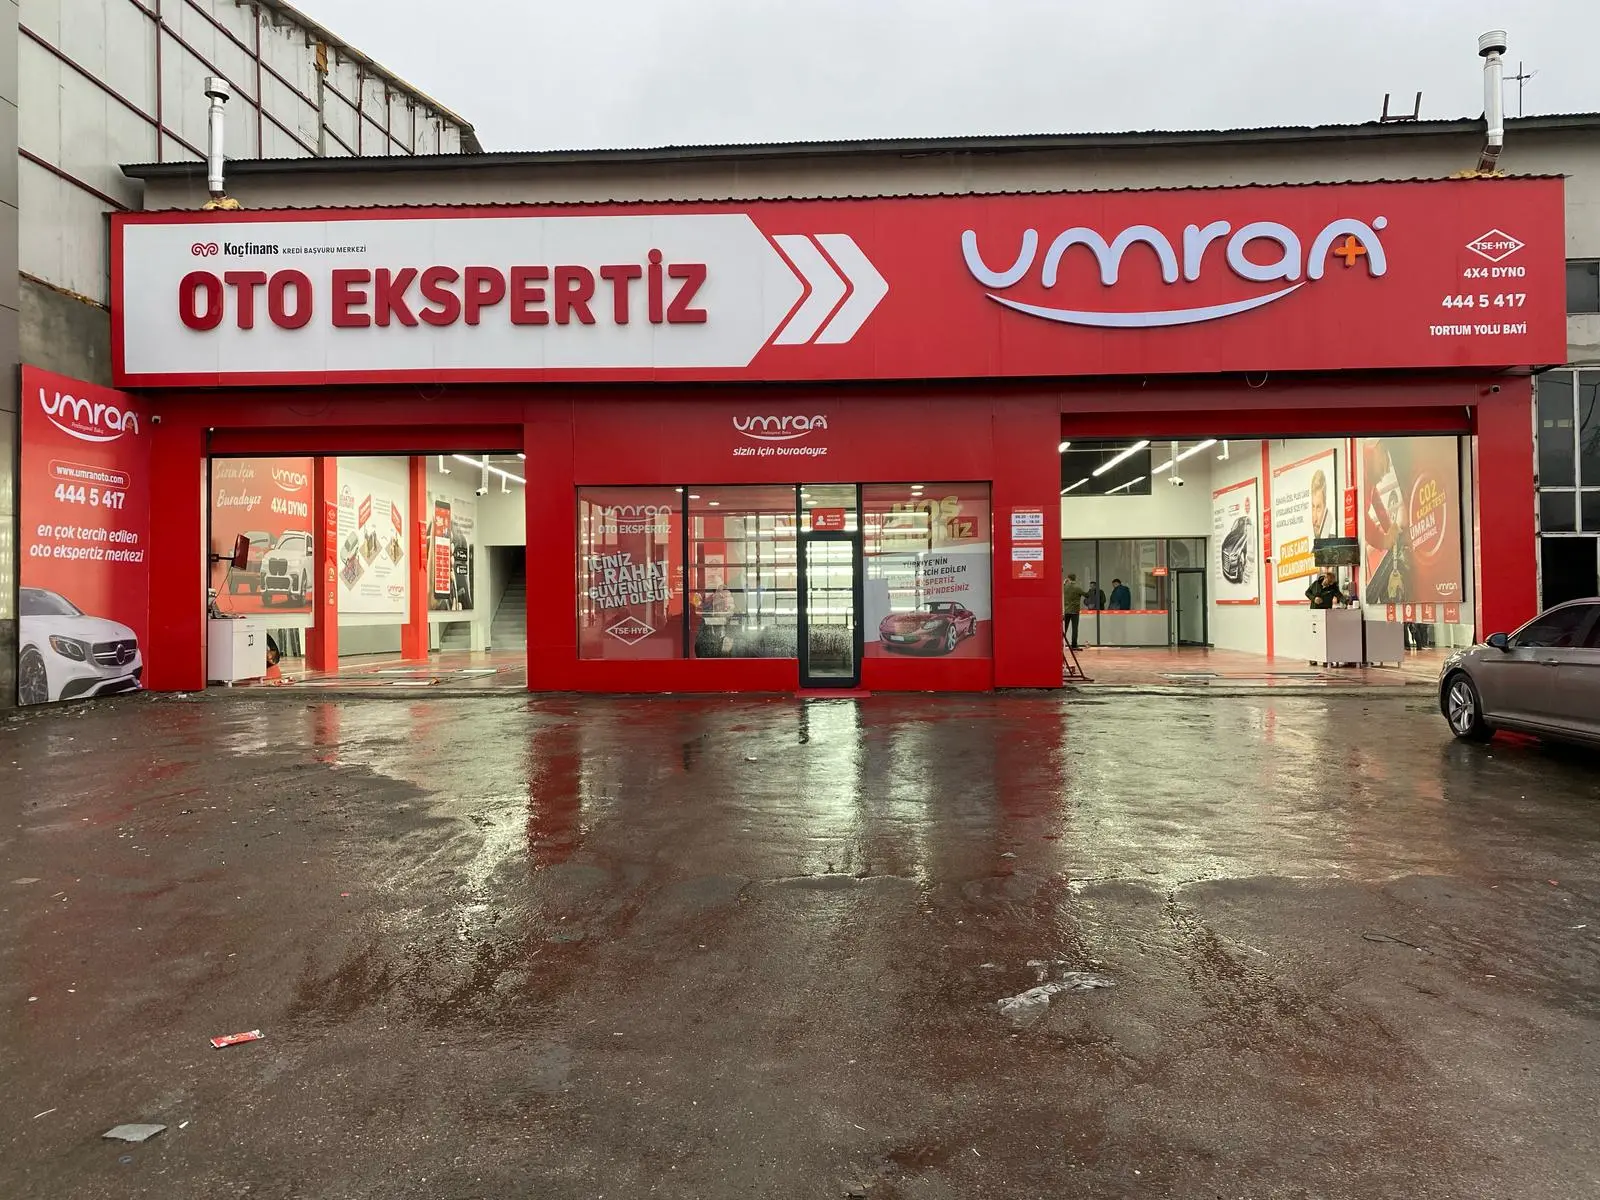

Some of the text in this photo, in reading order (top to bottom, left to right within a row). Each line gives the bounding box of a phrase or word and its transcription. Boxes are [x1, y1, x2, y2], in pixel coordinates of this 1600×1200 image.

[223, 242, 367, 257] Koçfinans KREDİ BAŞVURU MERKEZİ
[1474, 241, 1516, 250] TSE-HYB
[1463, 266, 1526, 278] 4X4 DYNO
[178, 248, 708, 331] OTO EKSPERTİZ
[1442, 293, 1527, 308] 444 5 417
[1429, 320, 1527, 336] TORTUM YOLU BAYİ
[40, 387, 139, 435] umran
[732, 414, 828, 431] umran
[732, 445, 828, 457] sizin için buradayız
[56, 466, 124, 484] www.umranoto.com
[271, 467, 308, 487] umran
[54, 483, 125, 509] 444 5 417
[1419, 479, 1438, 506] CO2
[271, 497, 308, 518] 4X4 DYNO
[37, 524, 138, 544] en çok tercih edilen
[598, 520, 672, 534] OTO EKSPERTİZ
[1409, 511, 1436, 541] UMRAN
[30, 543, 145, 563] oto ekspertiz merkezi
[588, 550, 632, 573] İÇİNİZ
[604, 560, 669, 586] RAHAT
[940, 564, 967, 575] EDİLEN
[588, 577, 667, 600] GÜVENİNİZ
[596, 586, 674, 610] TAM OLSUN
[613, 627, 649, 636] TSE-HYB
